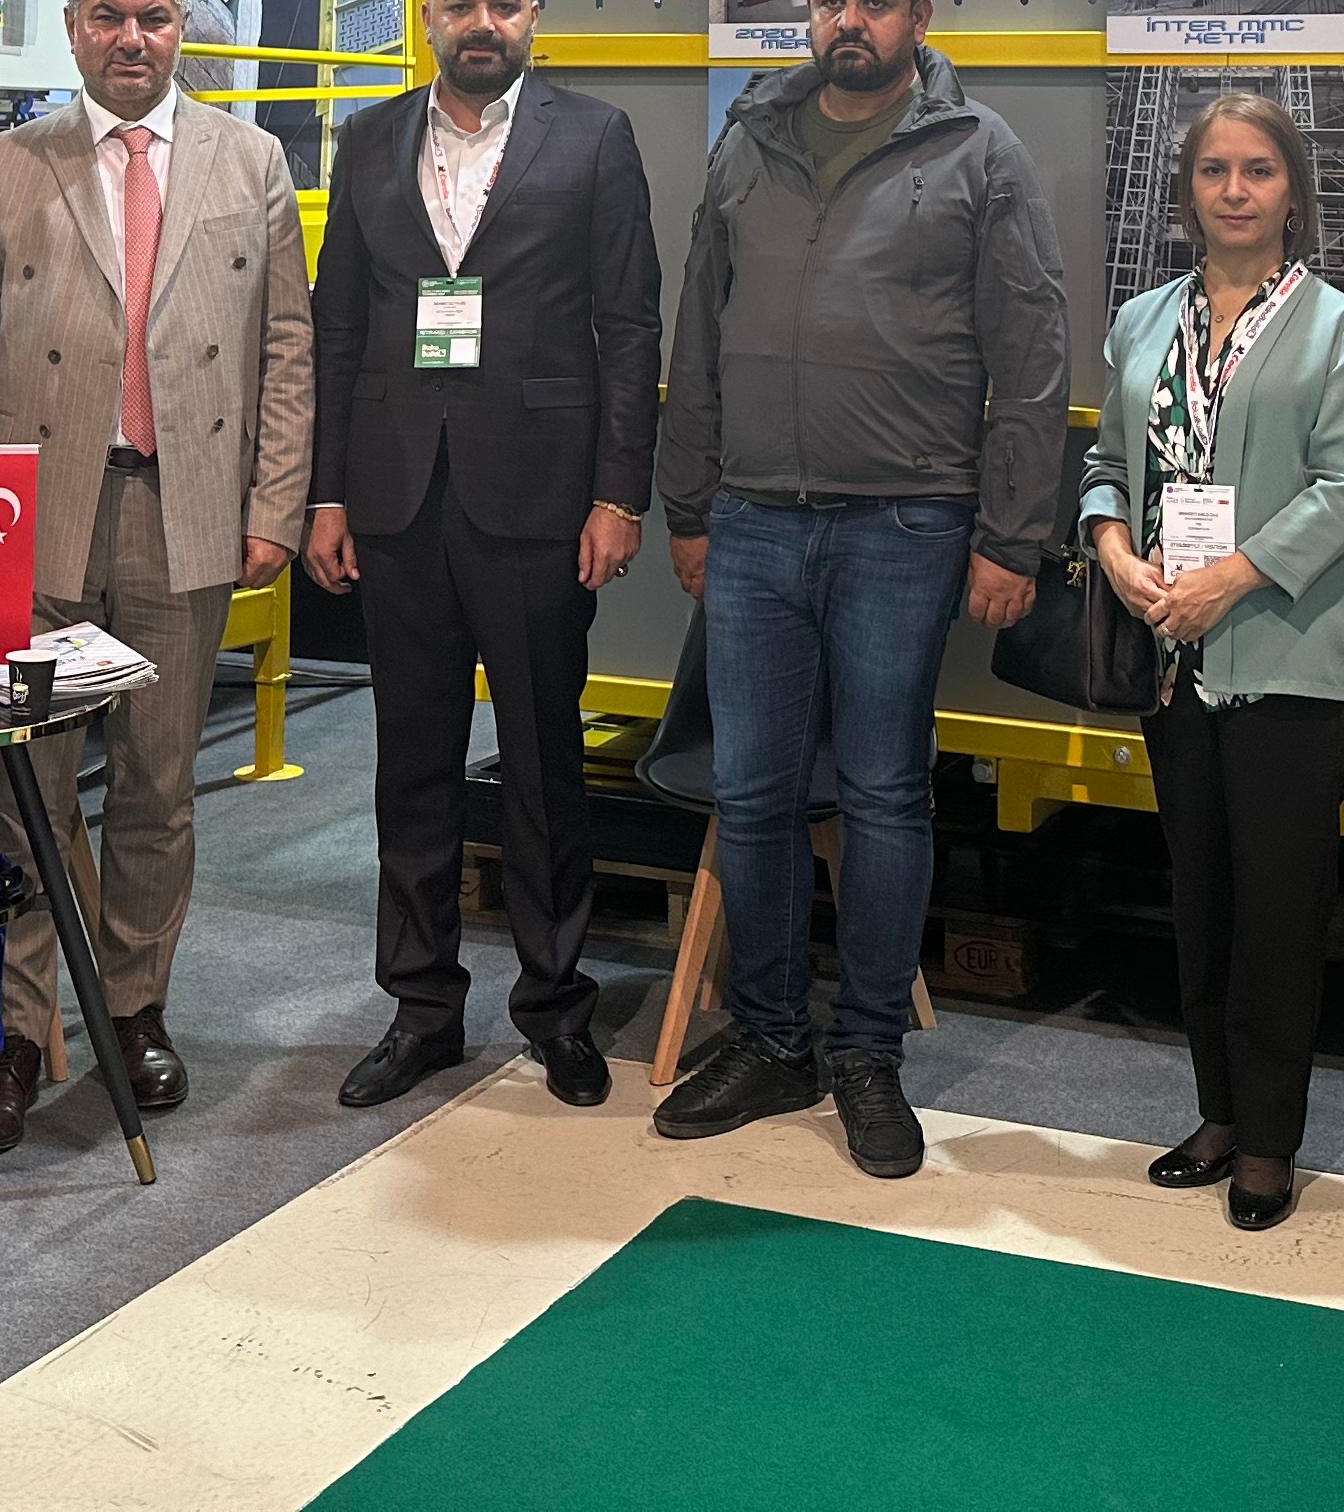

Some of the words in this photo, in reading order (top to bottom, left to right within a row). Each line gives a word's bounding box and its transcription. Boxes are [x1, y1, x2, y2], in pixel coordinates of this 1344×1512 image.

[1238, 19, 1305, 32] MMC
[735, 28, 797, 40] 2020
[967, 947, 998, 970] EUR
